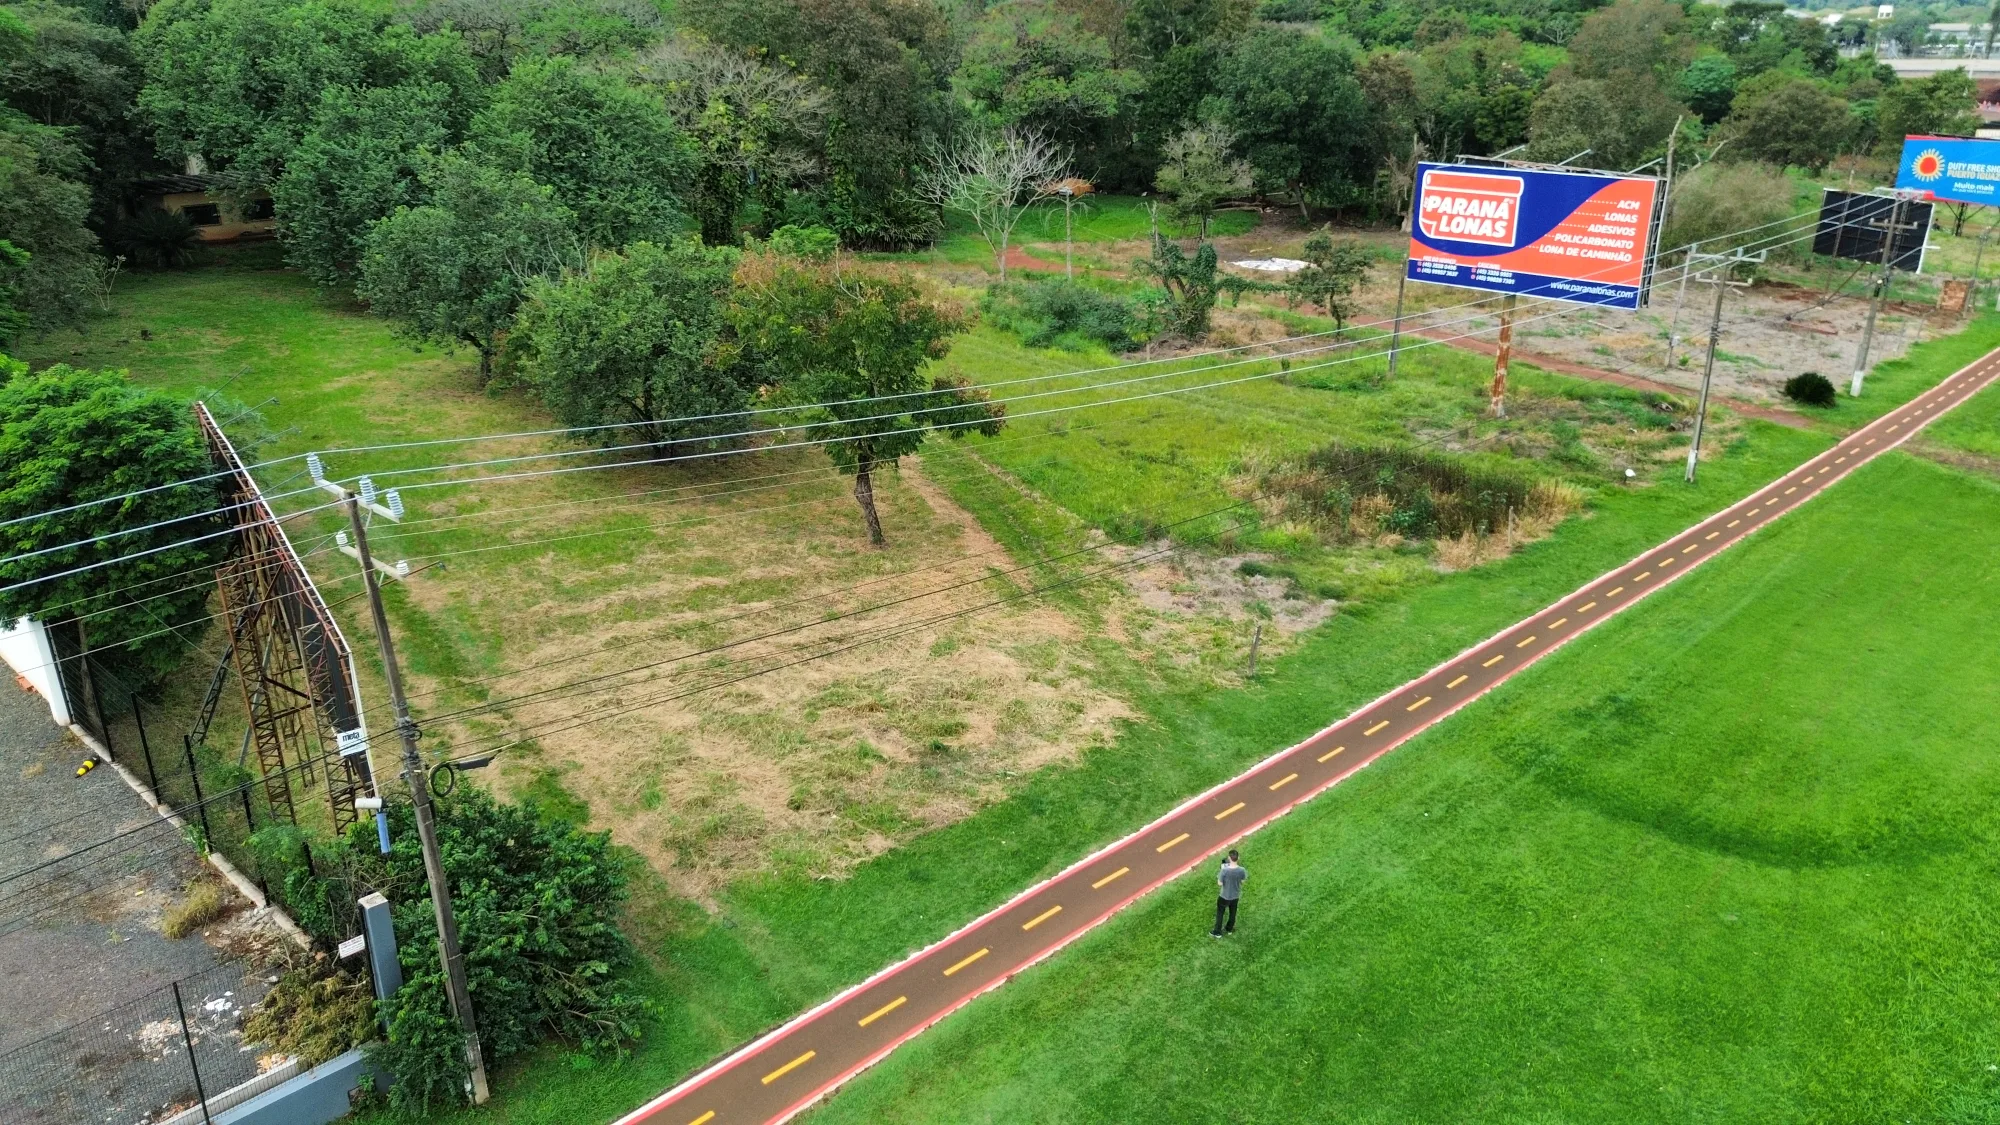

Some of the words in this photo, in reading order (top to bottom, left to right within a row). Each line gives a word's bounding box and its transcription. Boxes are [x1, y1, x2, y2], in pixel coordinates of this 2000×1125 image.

[1948, 162, 1967, 171] DUTY
[1967, 163, 1986, 172] FREE
[1947, 170, 1976, 179] PUERTO
[1954, 181, 1975, 190] Muito
[1976, 184, 1995, 192] mais
[1426, 195, 1509, 219] PARANÁ
[1617, 200, 1641, 210] ACM
[1604, 212, 1639, 224] LONAS
[1439, 215, 1508, 238] LONAS
[1587, 223, 1636, 236] ADESIVOS
[1554, 233, 1634, 249] POLICARBONATO
[1539, 244, 1565, 255] LONA
[1566, 247, 1580, 257] DE
[1580, 249, 1633, 262] CAMINHÃO
[1550, 281, 1634, 298] www.paranalonas.com
